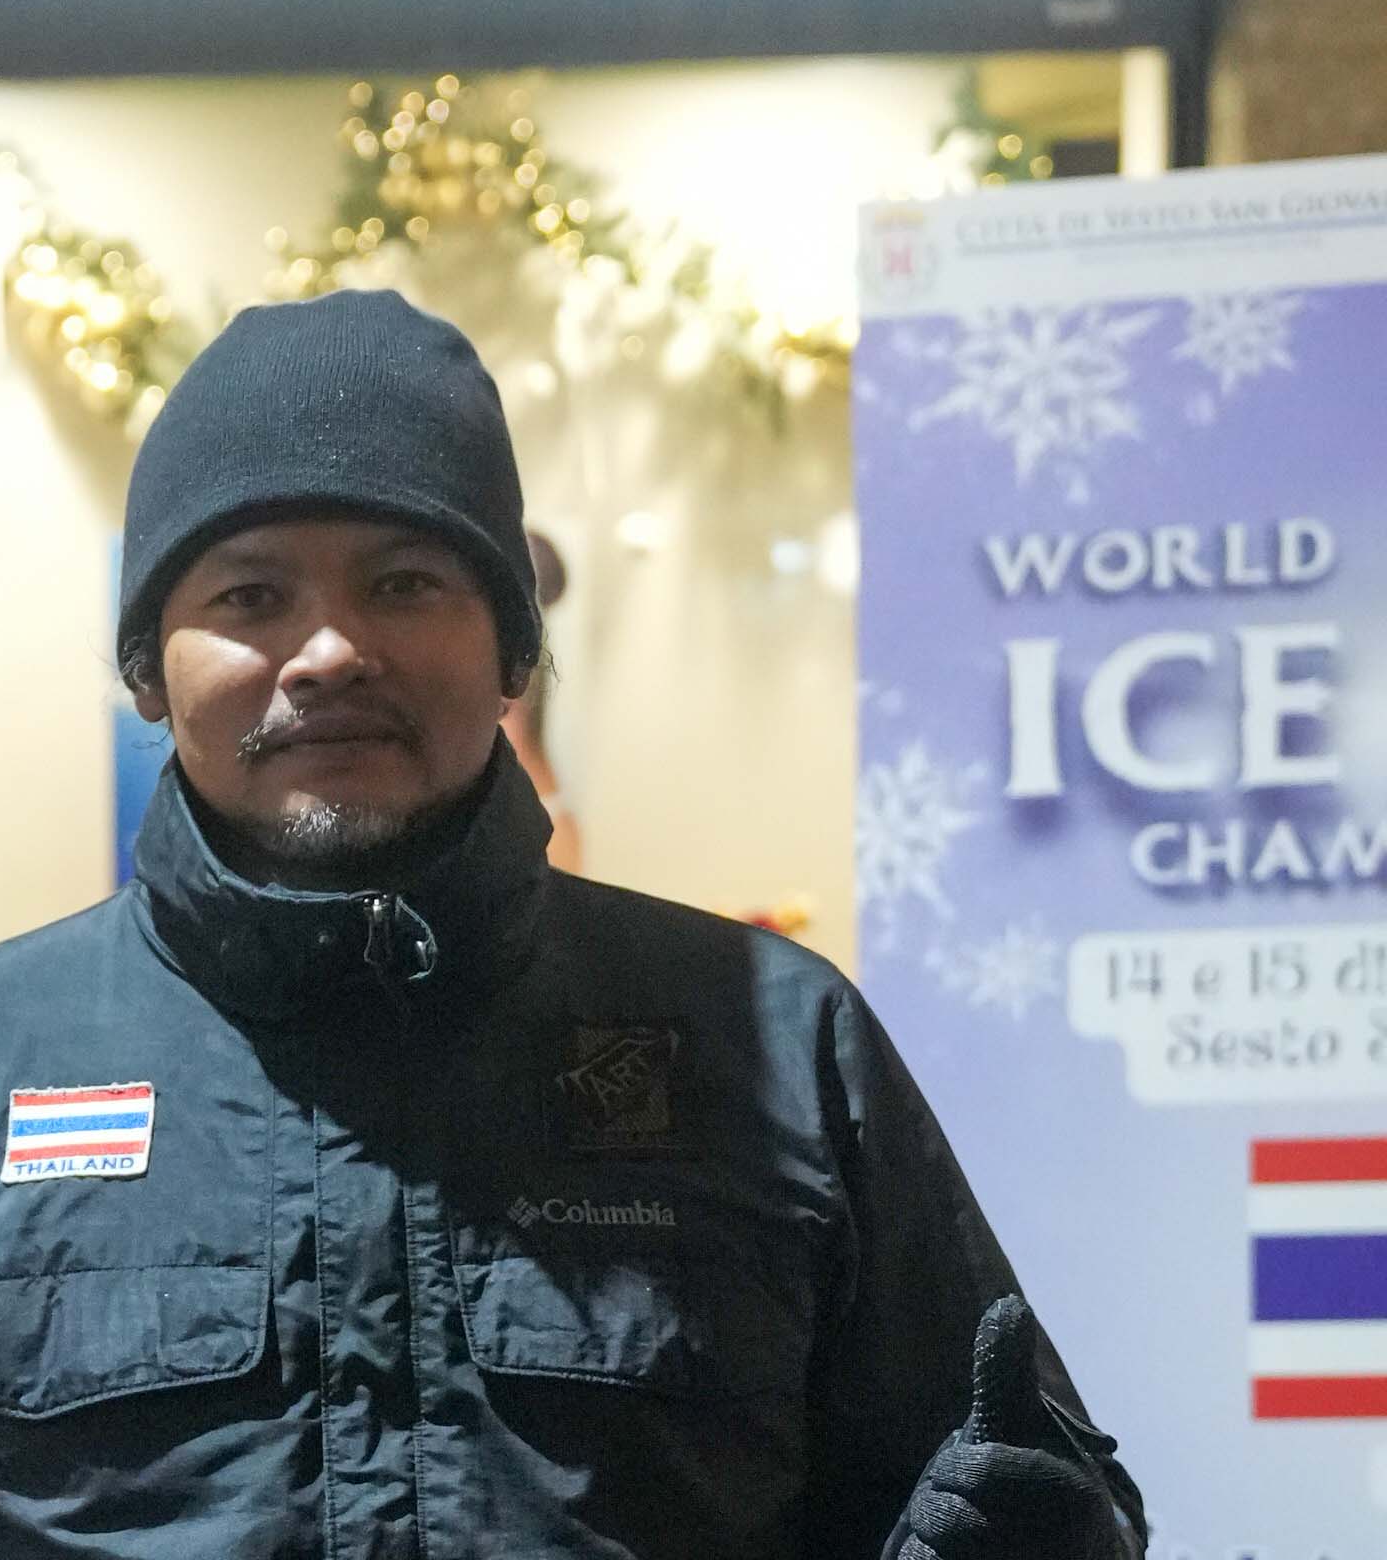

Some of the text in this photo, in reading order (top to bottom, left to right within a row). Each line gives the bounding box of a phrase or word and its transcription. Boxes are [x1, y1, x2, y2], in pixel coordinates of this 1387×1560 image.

[981, 516, 1334, 596] WORLD
[1004, 623, 1341, 797] ICE
[1107, 951, 1163, 1002] 14
[1192, 961, 1223, 998] e
[1251, 942, 1310, 998] 15
[1165, 1012, 1342, 1067] Sesto
[13, 1156, 135, 1177] THAILAND
[542, 1197, 676, 1227] Columbia
